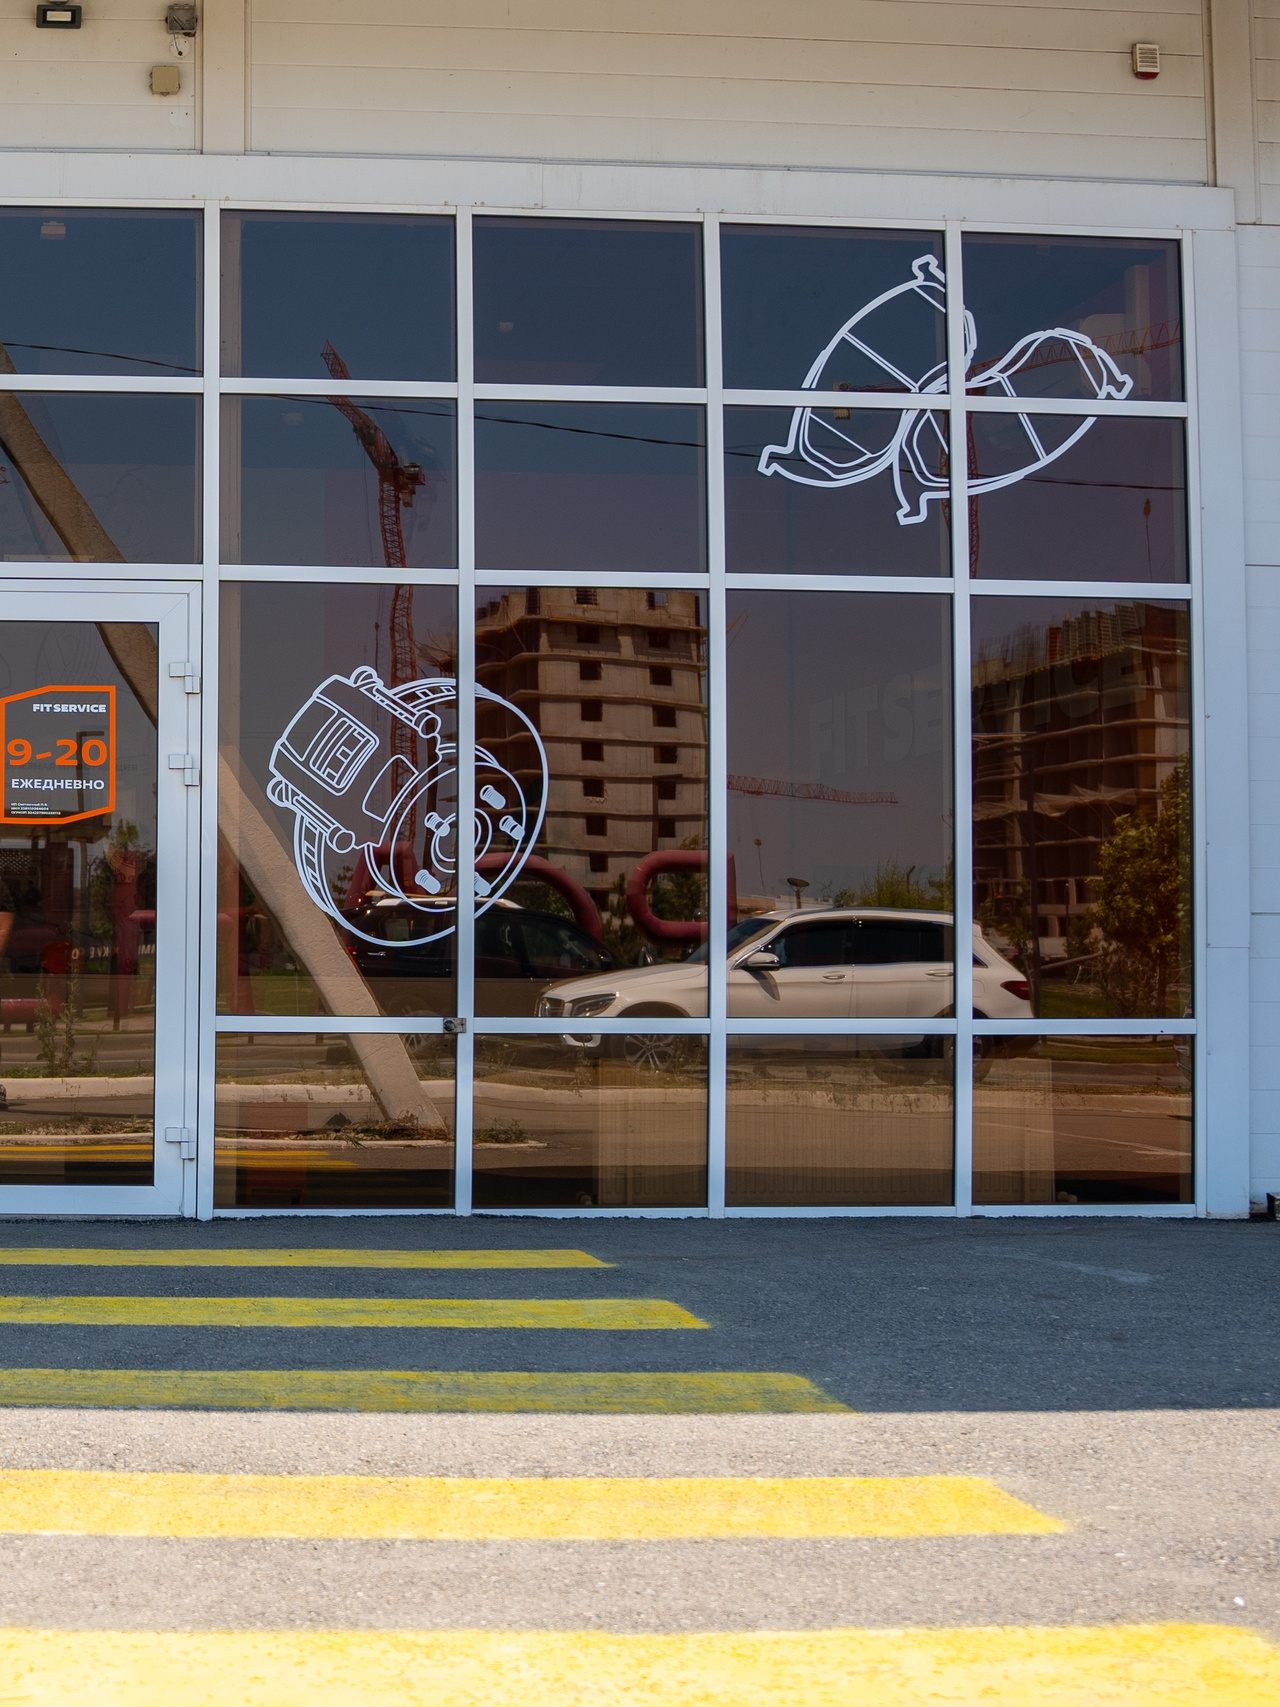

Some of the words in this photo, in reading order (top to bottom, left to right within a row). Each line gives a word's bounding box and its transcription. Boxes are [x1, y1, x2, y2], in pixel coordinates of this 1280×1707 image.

[32, 703, 52, 712] FIT
[53, 704, 107, 713] SERVICE
[6, 738, 108, 767] 9-20
[11, 778, 105, 791] ЕЖЕДНЕВНО
